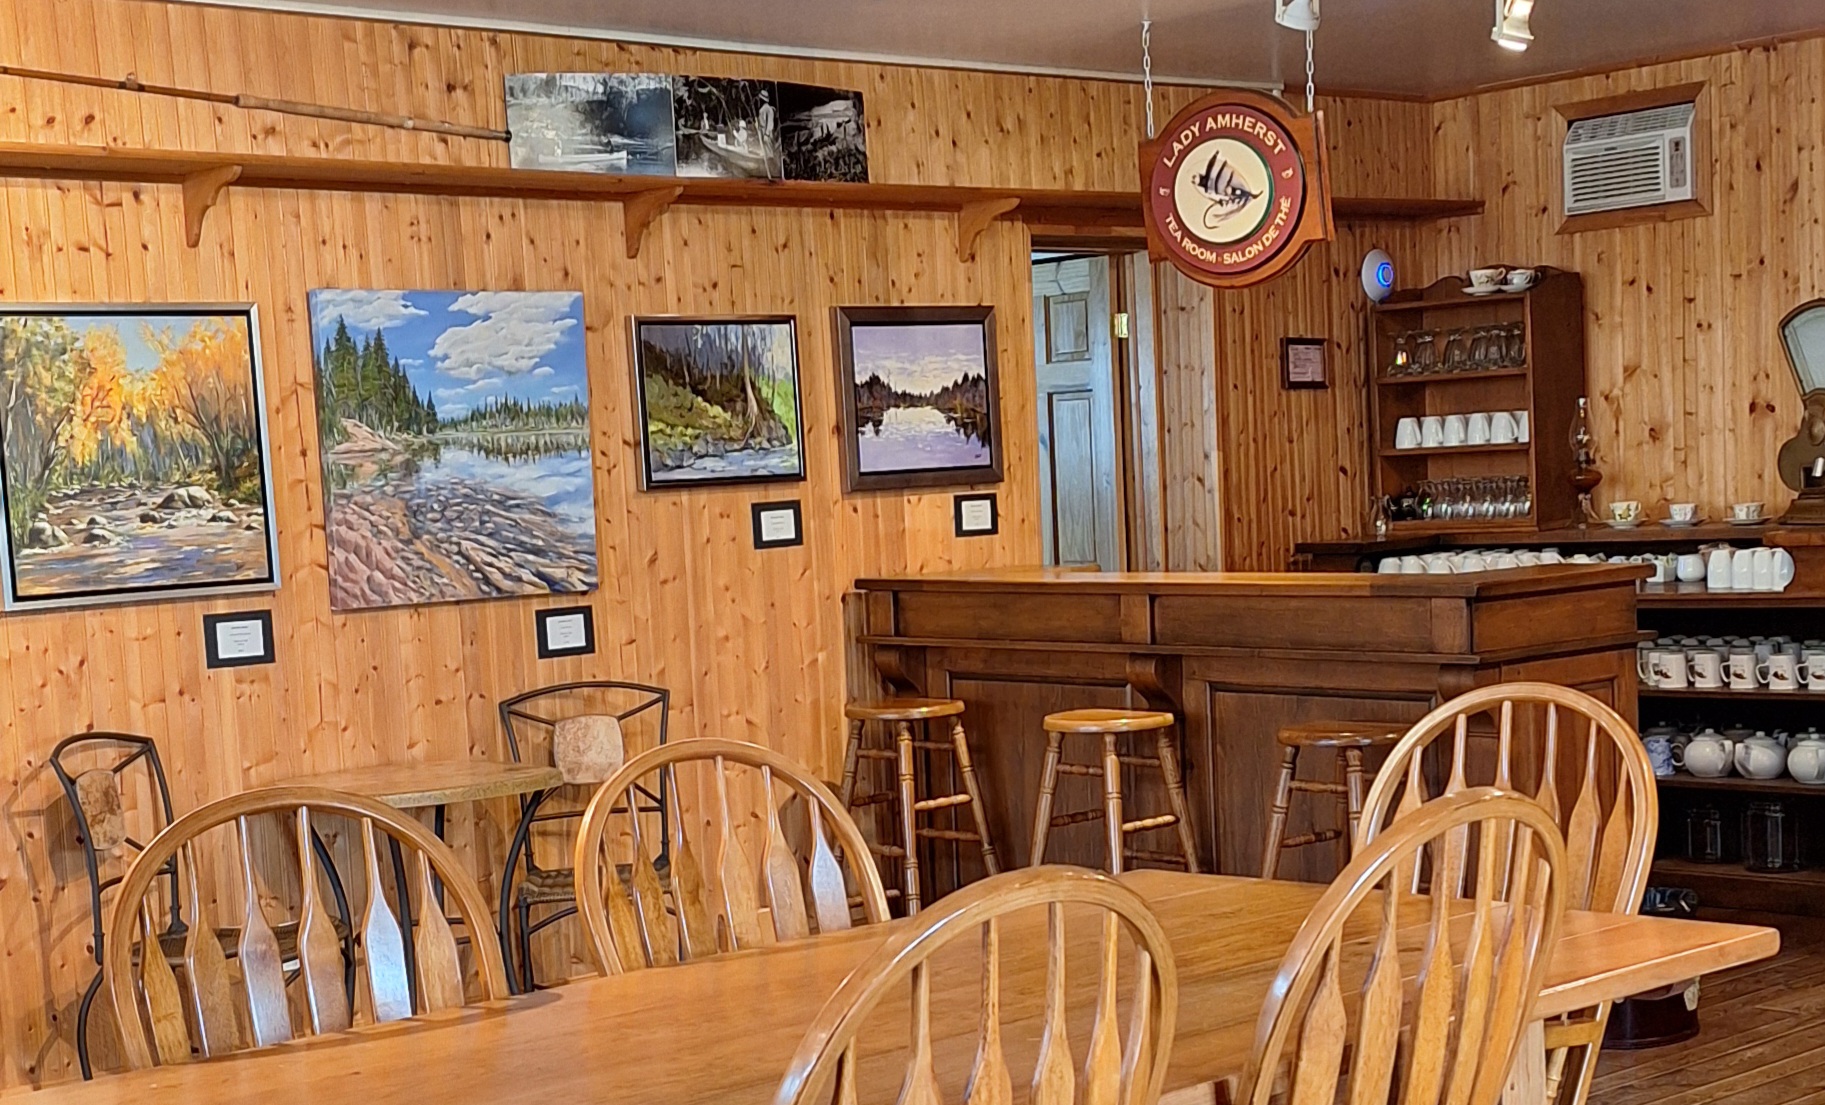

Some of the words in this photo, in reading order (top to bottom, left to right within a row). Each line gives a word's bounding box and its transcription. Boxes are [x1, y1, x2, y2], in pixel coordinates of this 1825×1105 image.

[1163, 122, 1201, 168] LADY
[1205, 113, 1286, 155] AMHERST
[1165, 213, 1181, 243] TEA
[1182, 237, 1216, 263] ROOM
[1223, 243, 1264, 265] SALON
[1262, 226, 1279, 247] DE
